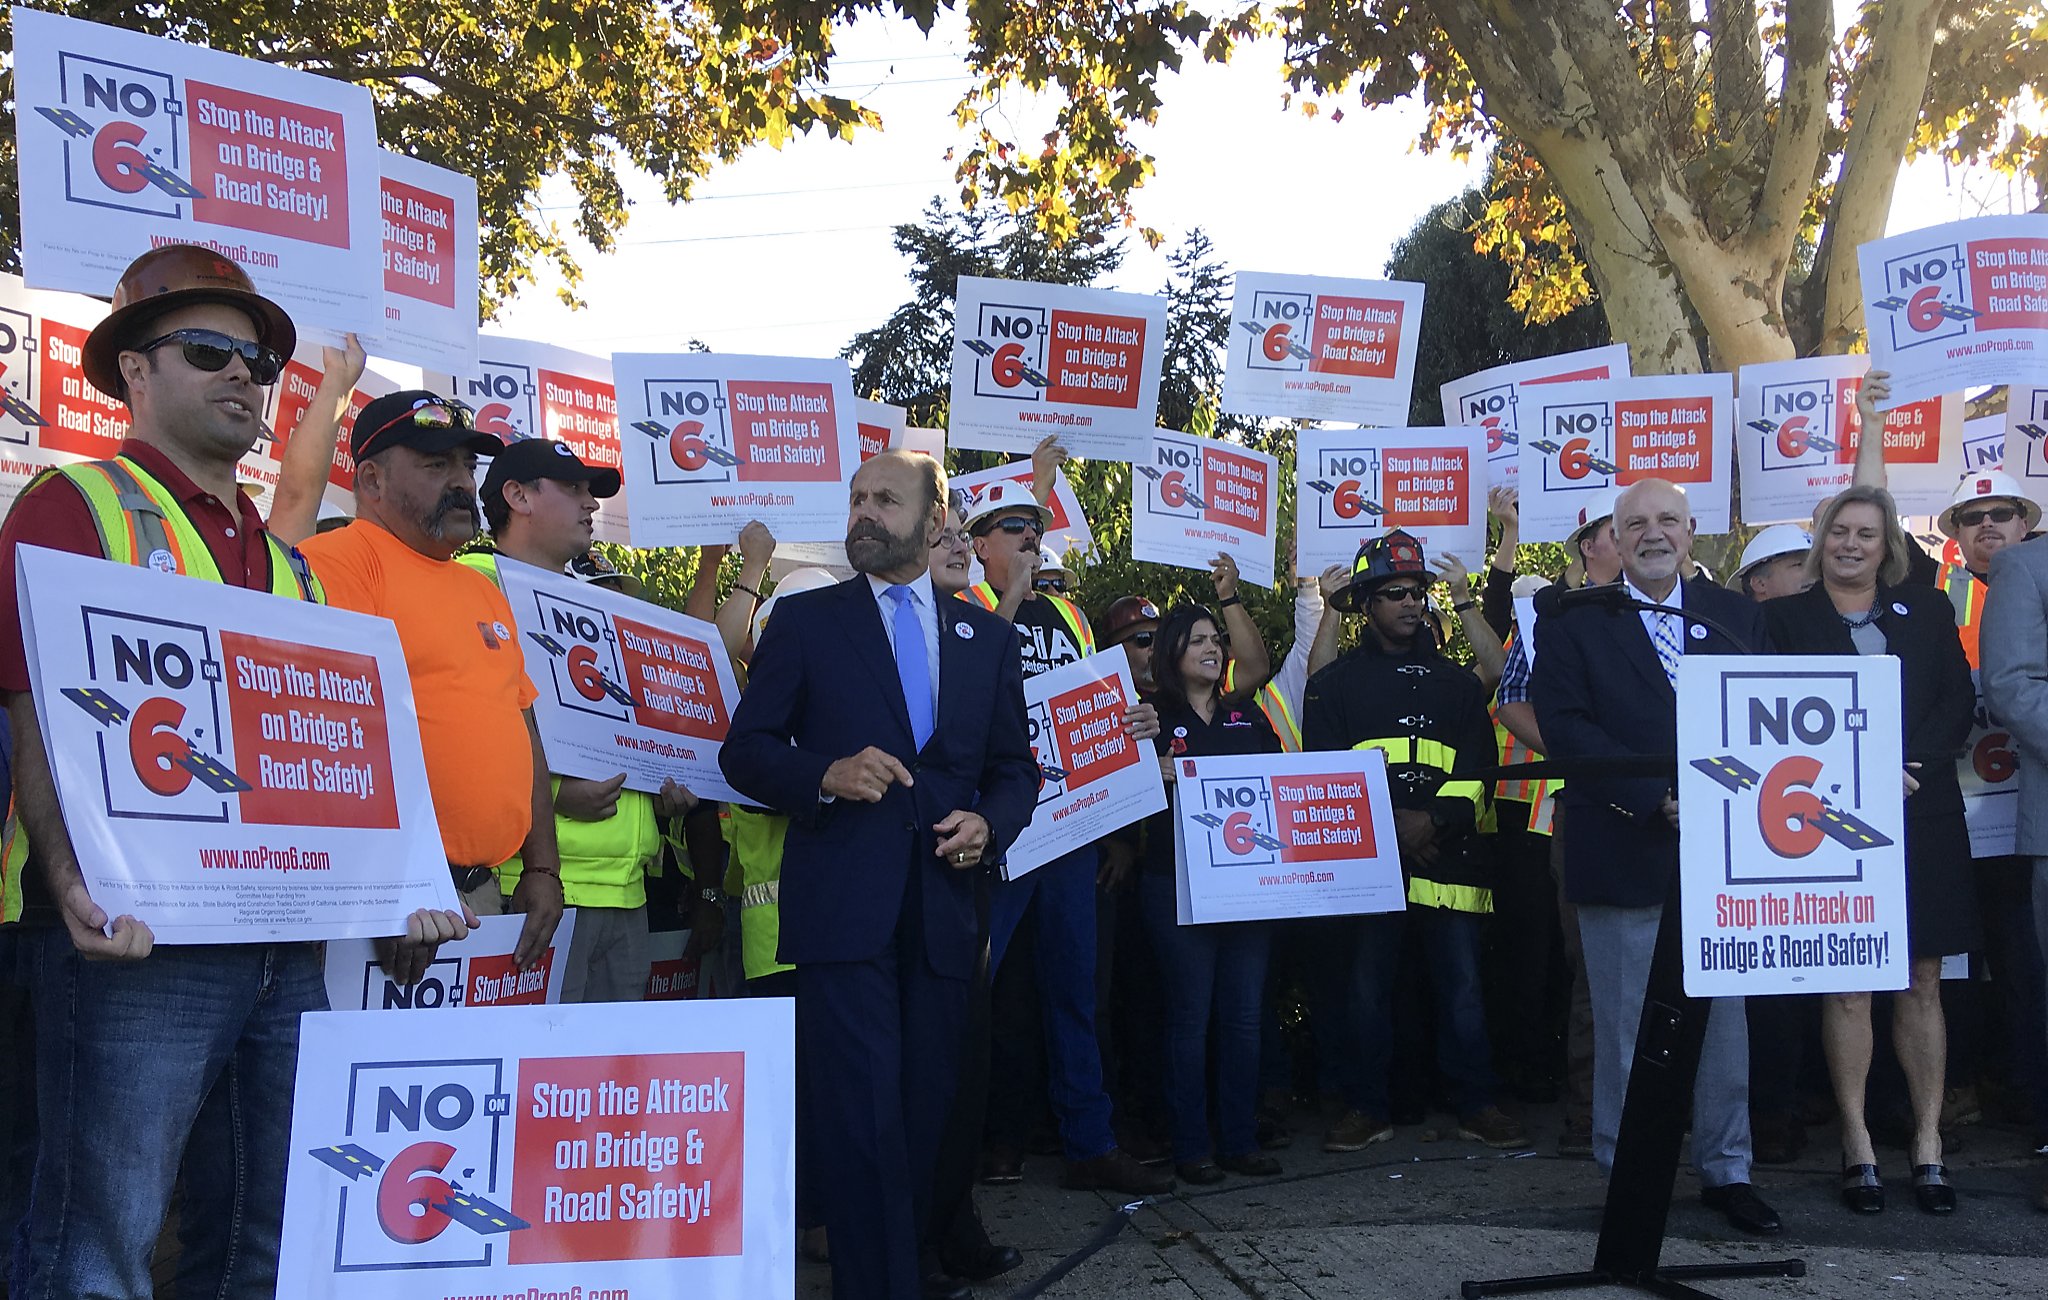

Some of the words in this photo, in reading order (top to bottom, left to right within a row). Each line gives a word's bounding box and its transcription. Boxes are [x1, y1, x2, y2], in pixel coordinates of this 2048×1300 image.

[83, 73, 156, 117] NO
[165, 102, 178, 114] ON
[198, 99, 240, 134] Stop
[244, 110, 274, 138] the
[280, 117, 335, 151] Attack
[92, 122, 148, 193] 6
[219, 143, 241, 166] on
[247, 144, 304, 181] Bridge
[309, 157, 321, 183] &
[215, 173, 262, 206] Road
[267, 184, 328, 221] Safety!
[382, 191, 403, 215] the
[407, 199, 448, 230] Attack
[383, 219, 424, 251] Bridge
[427, 233, 436, 254] &
[394, 253, 440, 285] Safety!
[1900, 259, 1947, 288] NO
[1976, 251, 2005, 268] Stop
[2008, 249, 2027, 265] the
[1991, 275, 2007, 289] on
[2010, 272, 2046, 290] Bridge
[1264, 301, 1300, 319] NO
[1321, 305, 1343, 322] Stop
[1346, 307, 1362, 321] the
[1364, 308, 1397, 324] Attack
[1907, 285, 1945, 333] 6
[1989, 295, 2020, 313] Road
[991, 315, 1033, 339] NO
[1057, 322, 1082, 342] Stop
[1085, 324, 1102, 342] the
[1104, 326, 1138, 345] Attack
[1263, 324, 1290, 361] 6
[50, 335, 80, 368] Stop
[991, 343, 1024, 388] 6
[1066, 349, 1079, 363] on
[1082, 348, 1116, 369] Bridge
[1119, 351, 1127, 368] &
[1947, 339, 2033, 359] www.noProp6.com
[63, 377, 80, 399] on
[469, 374, 518, 399] NO
[546, 383, 572, 407] Stop
[575, 390, 593, 408] the
[1061, 369, 1088, 387] Road
[1091, 372, 1128, 393] Safety!
[58, 404, 90, 433] Road
[661, 391, 709, 415] NO
[736, 393, 764, 414] Stop
[767, 394, 787, 411] the
[791, 394, 828, 412] Attack
[1019, 411, 1092, 427] www.noProp6.com
[1622, 411, 1647, 428] Stop
[1650, 410, 1668, 425] the
[1671, 407, 1706, 424] Attack
[1774, 391, 1817, 414] NO
[751, 422, 767, 436] on
[769, 419, 808, 440] Bridge
[811, 420, 819, 438] &
[1556, 413, 1597, 435] NO
[1776, 416, 1808, 459] 6
[1884, 431, 1925, 448] Safety!
[669, 421, 707, 472] 6
[750, 444, 781, 463] Road
[784, 445, 825, 466] Safety!
[1158, 447, 1190, 468] NO
[1559, 438, 1591, 480] 6
[1331, 457, 1366, 476] NO
[1388, 457, 1410, 474] Stop
[1413, 457, 1428, 471] the
[1431, 456, 1463, 471] Attack
[711, 493, 794, 507] www.noProp6.com
[1333, 480, 1361, 519] 6
[552, 607, 599, 643] NO
[112, 634, 193, 689] NO
[204, 663, 217, 678] ON
[623, 629, 652, 657] Stop
[652, 638, 672, 660] the
[673, 643, 709, 671] Attack
[236, 656, 281, 698] Stop
[284, 664, 315, 698] the
[319, 668, 375, 706] Attack
[566, 645, 605, 702] 6
[642, 664, 657, 683] on
[658, 665, 695, 694] Bridge
[696, 676, 705, 695] &
[643, 687, 675, 713] Road
[675, 696, 716, 724] Safety!
[1056, 706, 1077, 725] Stop
[1077, 699, 1092, 717] the
[1093, 686, 1121, 711] Attack
[1749, 696, 1835, 745] NO
[1849, 713, 1863, 727] ON
[261, 713, 286, 741] on
[289, 710, 347, 752] Bridge
[351, 718, 363, 749] &
[1070, 729, 1082, 745] on
[1081, 718, 1110, 740] Bridge
[1111, 712, 1118, 728] &
[128, 697, 192, 796] 6
[614, 734, 696, 760] www.noProp6.com
[1072, 746, 1095, 770] Road
[1095, 733, 1126, 760] Safety!
[259, 754, 309, 790] Road
[312, 759, 374, 799] Safety!
[1279, 786, 1304, 803] Stop
[1306, 784, 1324, 800] the
[1327, 782, 1362, 799] Attack
[1052, 788, 1109, 822] www.noProp6.com
[1215, 787, 1256, 808] NO
[1293, 810, 1307, 823] on
[1309, 806, 1345, 823] Bridge
[1347, 805, 1355, 820] &
[1758, 755, 1827, 859] 6
[1223, 812, 1255, 855] 6
[1292, 829, 1321, 845] Road
[1323, 827, 1362, 845] Safety!
[199, 846, 330, 873] www.noProp6.com
[1259, 871, 1334, 886] www.noProp6.com
[1716, 894, 1756, 931] Stop
[1761, 892, 1789, 926] the
[1793, 891, 1850, 925] Attack
[1854, 895, 1875, 923] on
[1701, 936, 1758, 974] Bridge
[1763, 935, 1776, 969] &
[1780, 933, 1823, 968] Road
[1828, 931, 1889, 969] Safety!
[383, 978, 445, 1010] NO
[474, 975, 499, 1004] Stop
[501, 972, 516, 994] the
[517, 965, 546, 993] Attack
[376, 1083, 474, 1133] NO
[487, 1098, 505, 1112] ON
[533, 1083, 591, 1122] Stop
[598, 1080, 638, 1115] the
[646, 1077, 729, 1114] Attack
[556, 1140, 587, 1169] on
[595, 1131, 678, 1172] Bridge
[686, 1129, 704, 1164] &
[377, 1142, 456, 1244] 6
[545, 1184, 612, 1223] Road
[620, 1180, 710, 1223] Safety!
